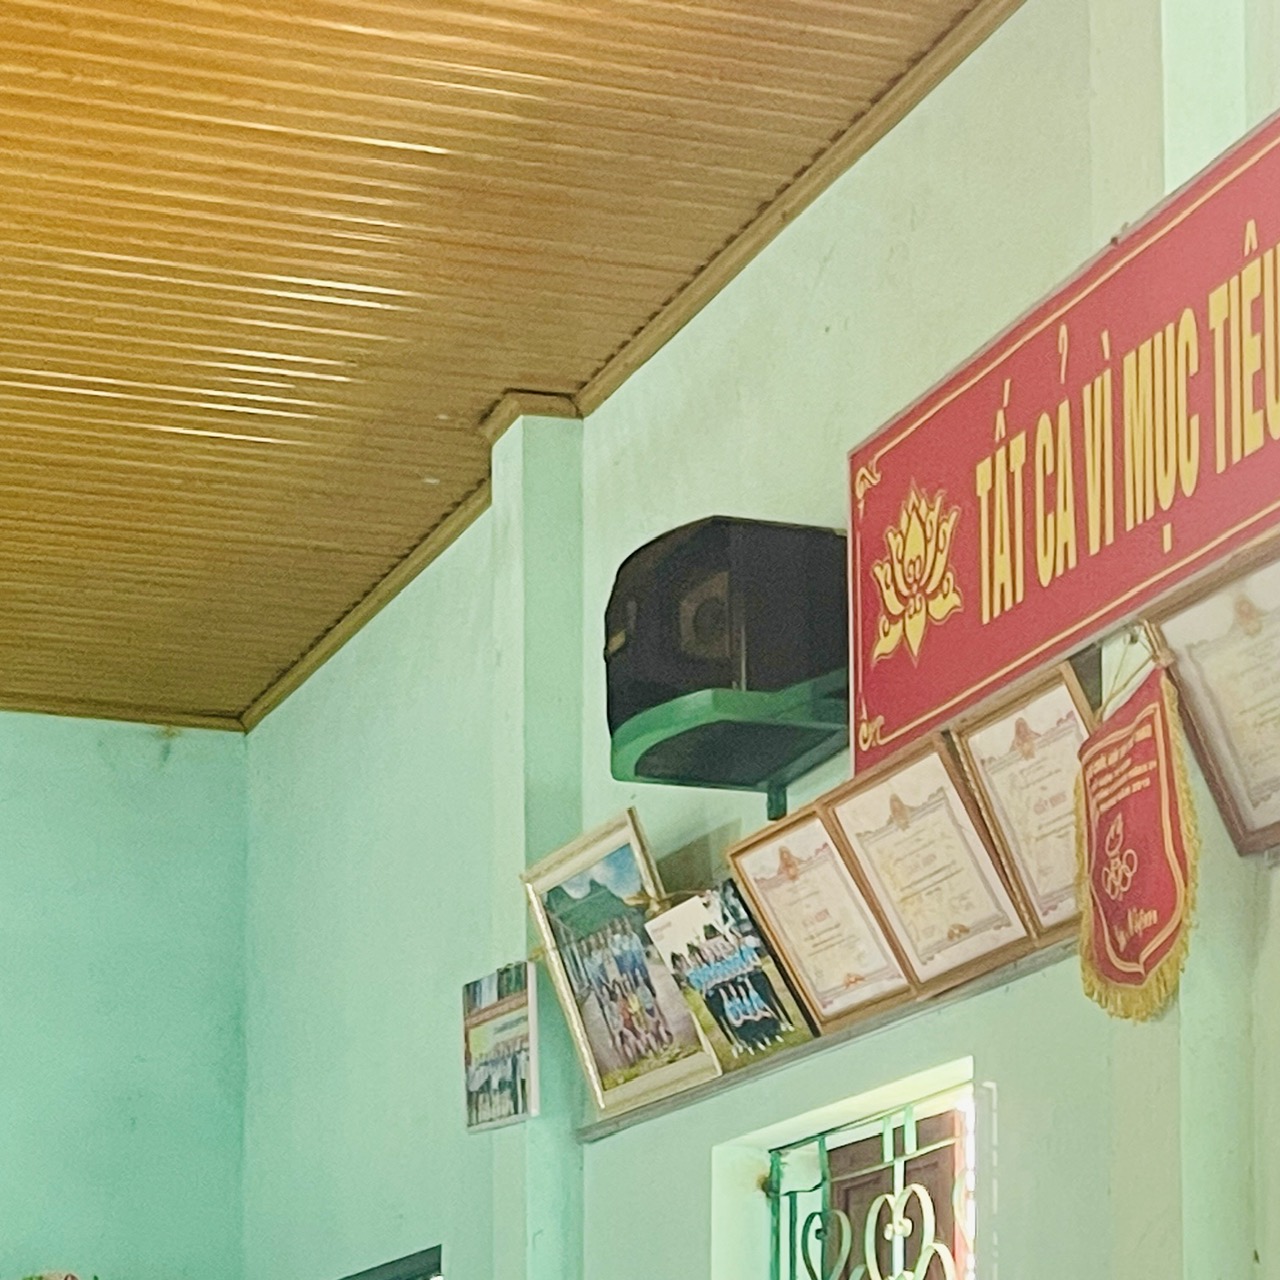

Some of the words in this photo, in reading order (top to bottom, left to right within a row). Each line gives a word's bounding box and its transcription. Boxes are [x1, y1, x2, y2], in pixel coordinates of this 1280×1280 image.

[976, 378, 1026, 625] TẤT
[1035, 323, 1077, 588] CẢ
[1083, 329, 1114, 556] VÌ
[1123, 307, 1200, 554] MỤC
